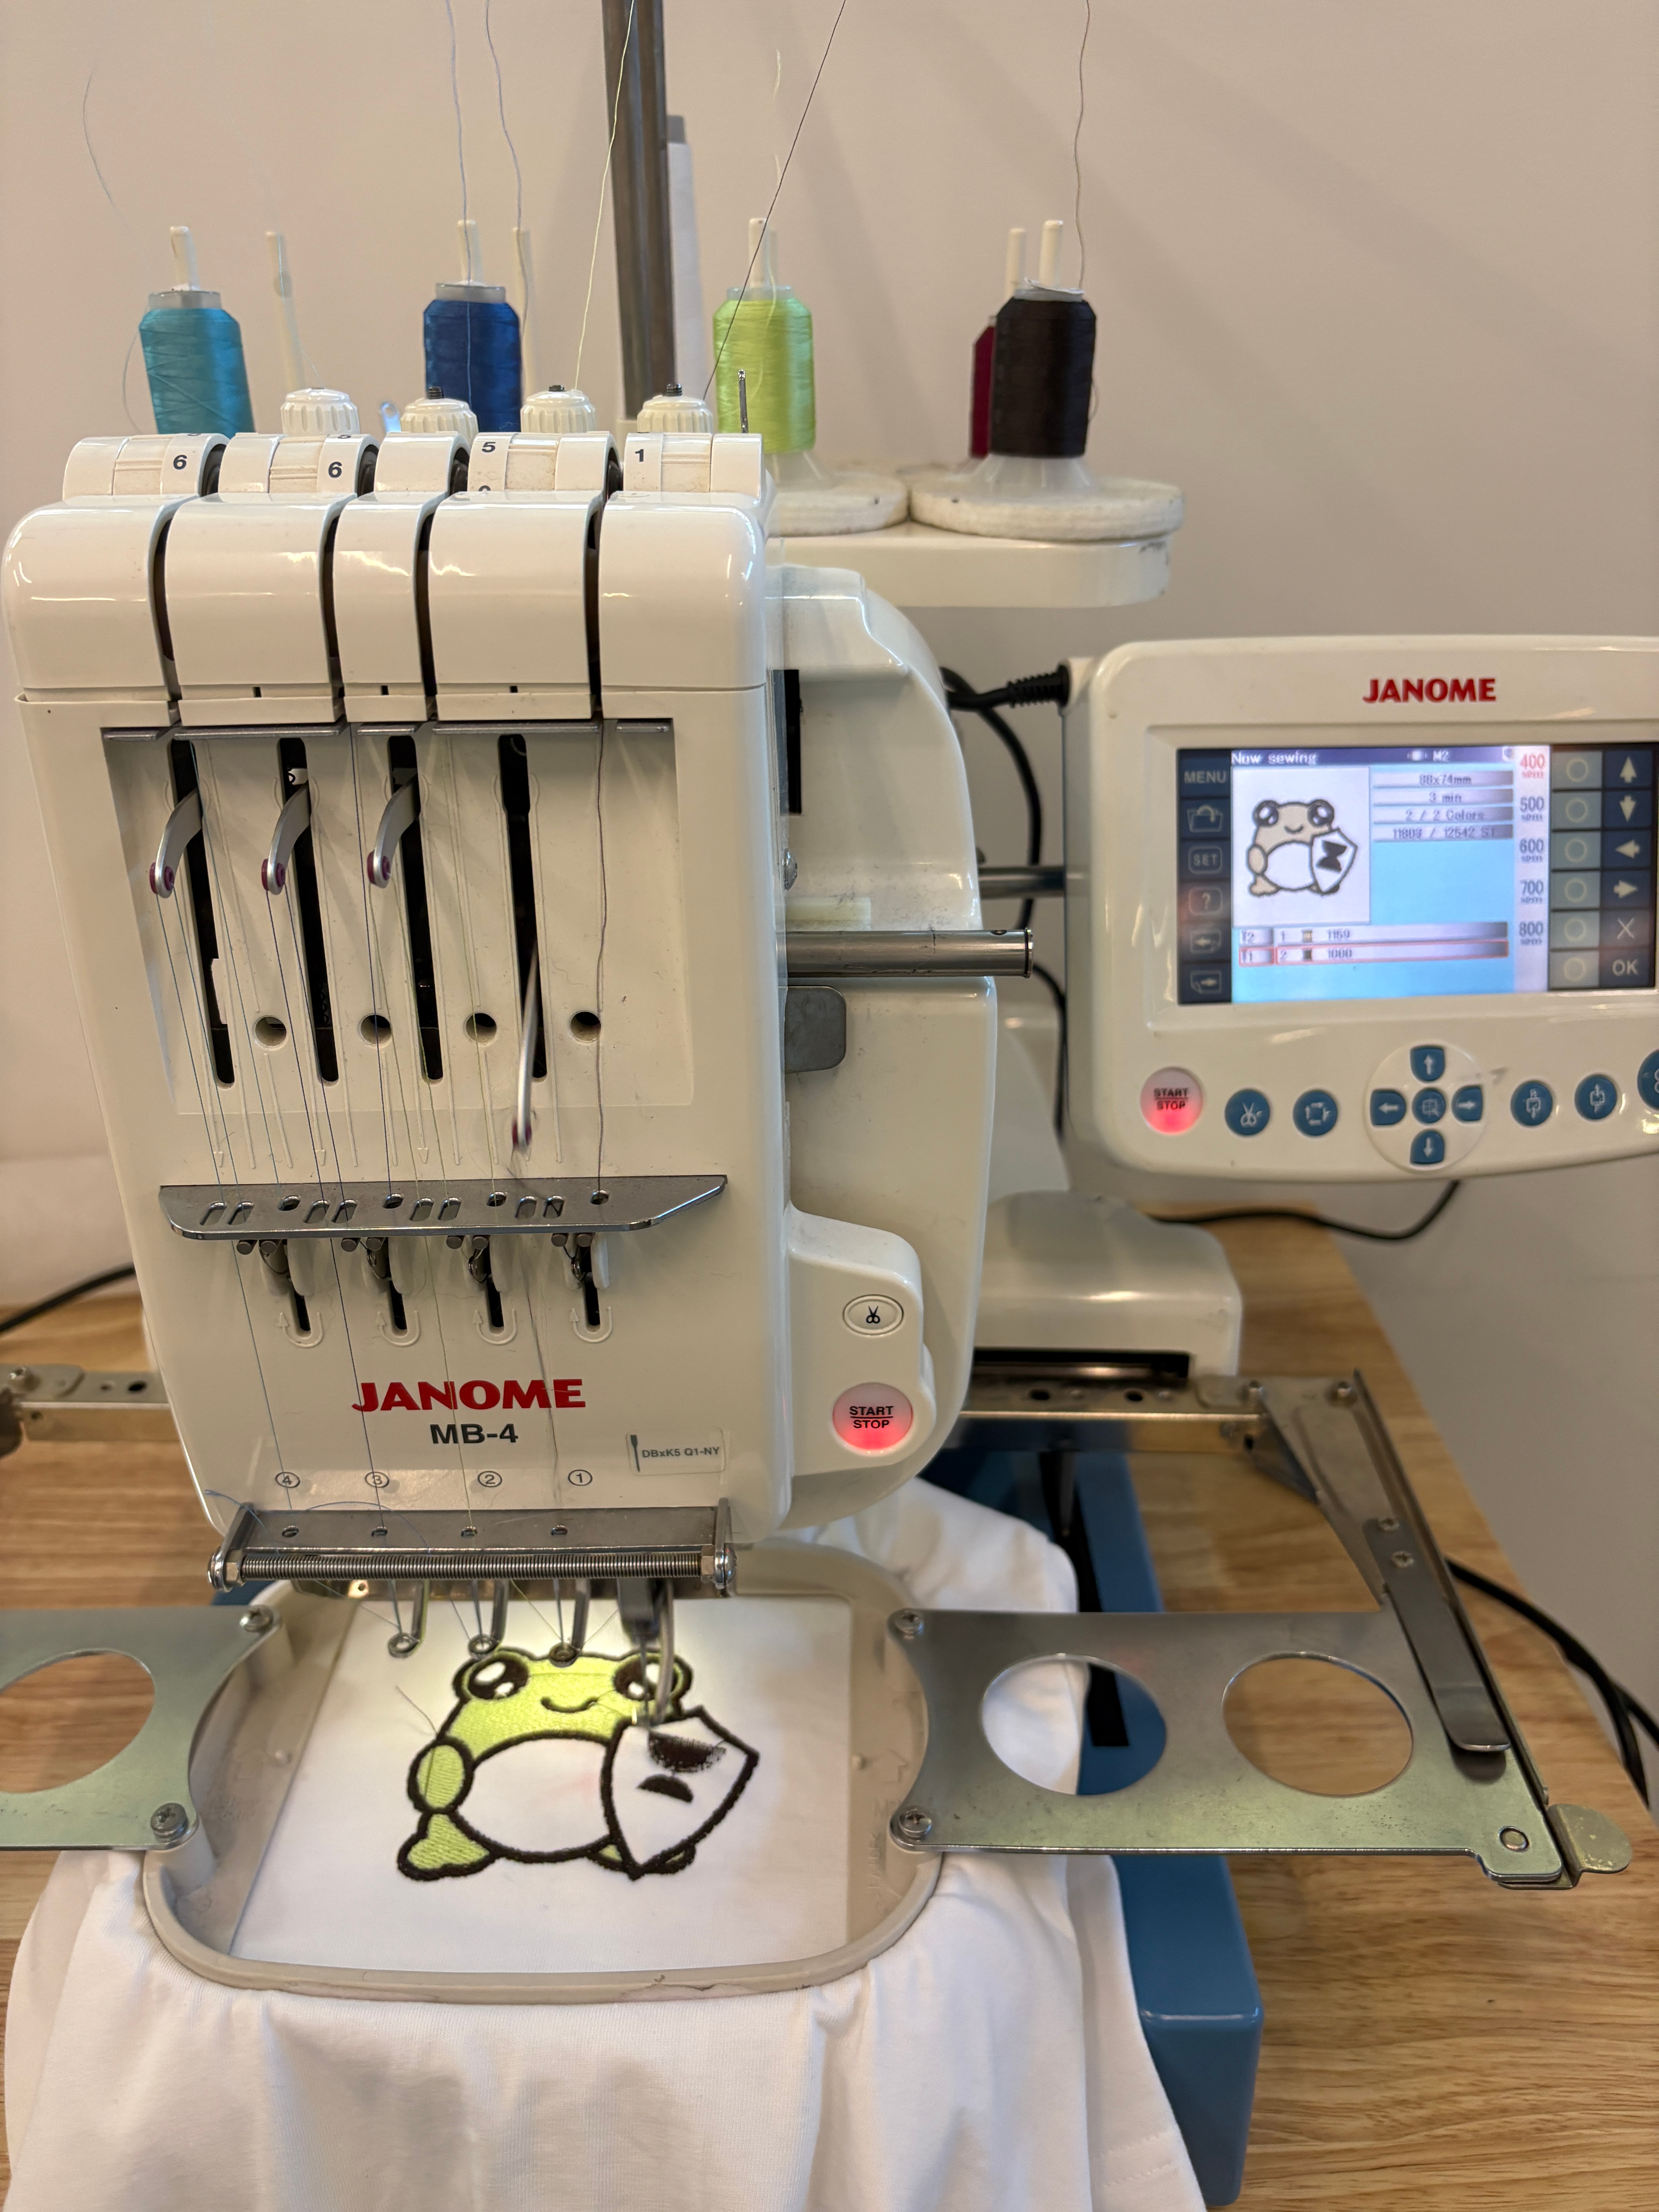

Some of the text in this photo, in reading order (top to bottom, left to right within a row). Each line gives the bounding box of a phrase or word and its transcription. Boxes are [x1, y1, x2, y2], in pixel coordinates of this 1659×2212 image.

[481, 441, 496, 453] 5
[173, 454, 188, 470] 6
[635, 449, 644, 462] 1
[328, 461, 342, 478] 6
[1362, 678, 1497, 704] JANOME
[1231, 750, 1317, 766] Now sewing
[1520, 753, 1545, 769] 400
[1184, 771, 1226, 783] MENU
[1429, 791, 1463, 804] 3 min
[1520, 795, 1544, 812] 500
[1405, 808, 1485, 822] 2 / 2 Colors
[1429, 828, 1435, 839] /
[1519, 838, 1544, 853] 600
[1193, 853, 1218, 866] SET
[1520, 879, 1544, 895] 700
[1519, 921, 1544, 937] 800
[1612, 959, 1639, 976] OK
[1153, 1087, 1189, 1097] START
[1157, 1100, 1186, 1111] STOP
[351, 1378, 586, 1412] JANOME
[849, 1406, 894, 1416] START
[853, 1420, 890, 1429] STOP
[429, 1423, 519, 1444] MB-4
[641, 1446, 720, 1458] DBxK5 Q1-NY
